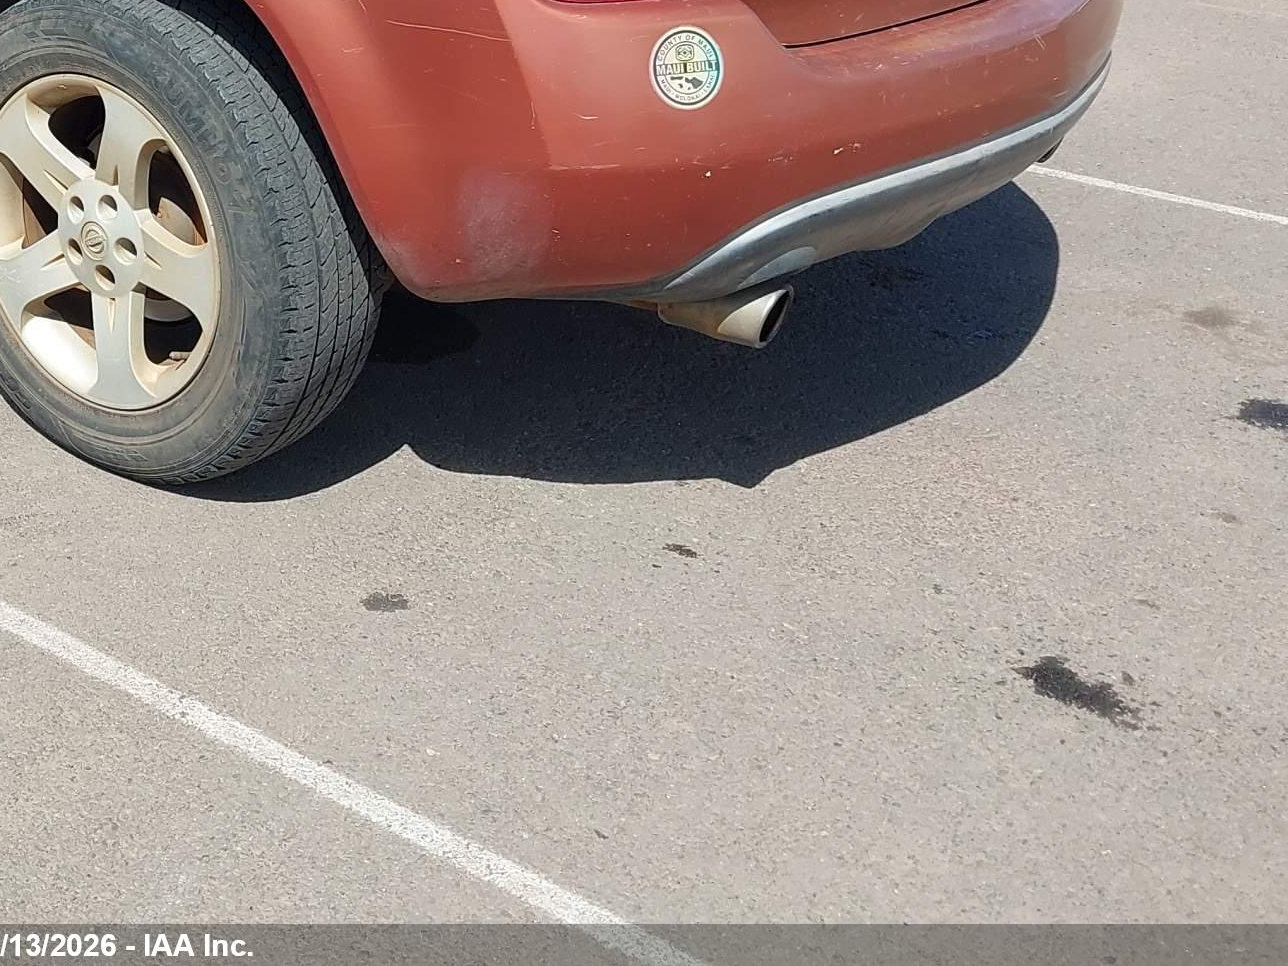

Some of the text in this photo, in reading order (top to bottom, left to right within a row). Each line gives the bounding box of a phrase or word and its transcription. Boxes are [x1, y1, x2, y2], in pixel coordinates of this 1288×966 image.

[657, 35, 682, 62] COUNTY
[698, 38, 713, 59] MAUI
[656, 60, 717, 76] MAUI BUILT
